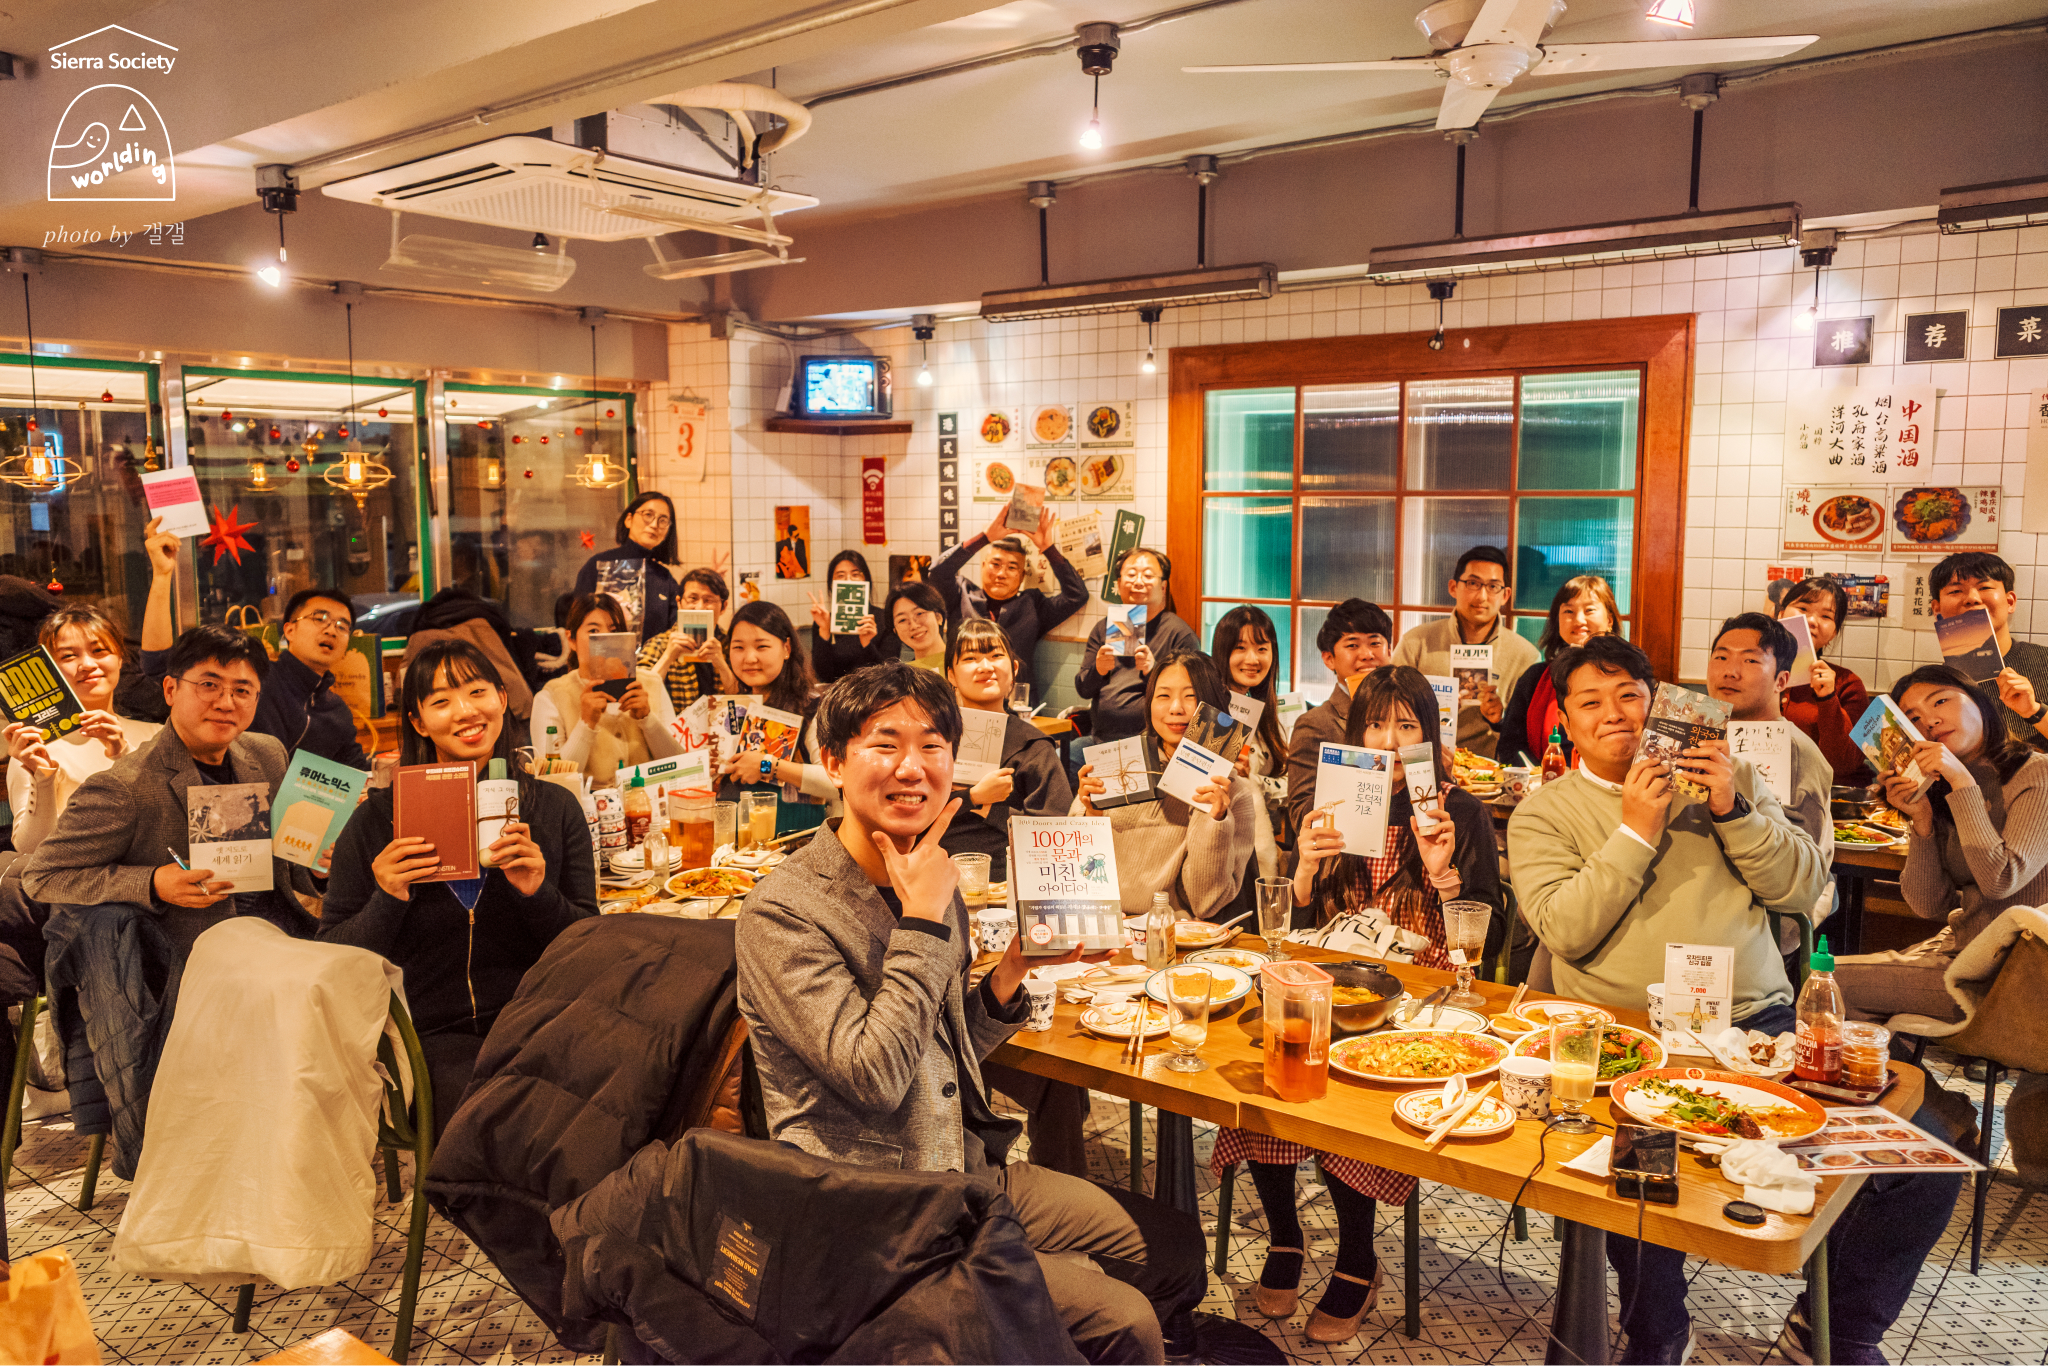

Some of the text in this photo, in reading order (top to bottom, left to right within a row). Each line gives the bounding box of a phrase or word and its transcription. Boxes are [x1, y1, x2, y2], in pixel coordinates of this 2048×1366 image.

[2017, 316, 2042, 343] 菜
[678, 422, 694, 458] 3
[1829, 404, 1845, 466] 洋河大曲
[1850, 404, 1868, 466] 孔府家酒
[1897, 400, 1922, 467] 中国酒
[299, 766, 351, 793] 휴머노믹스
[1357, 781, 1383, 795] 정치의
[1355, 793, 1382, 807] 도덕적
[1355, 804, 1373, 816] 기초
[1031, 830, 1094, 848] 100개의
[233, 854, 252, 865] 읽기
[1051, 848, 1082, 863] 문과
[1039, 863, 1077, 882] 미친
[1038, 882, 1089, 896] 아이디어
